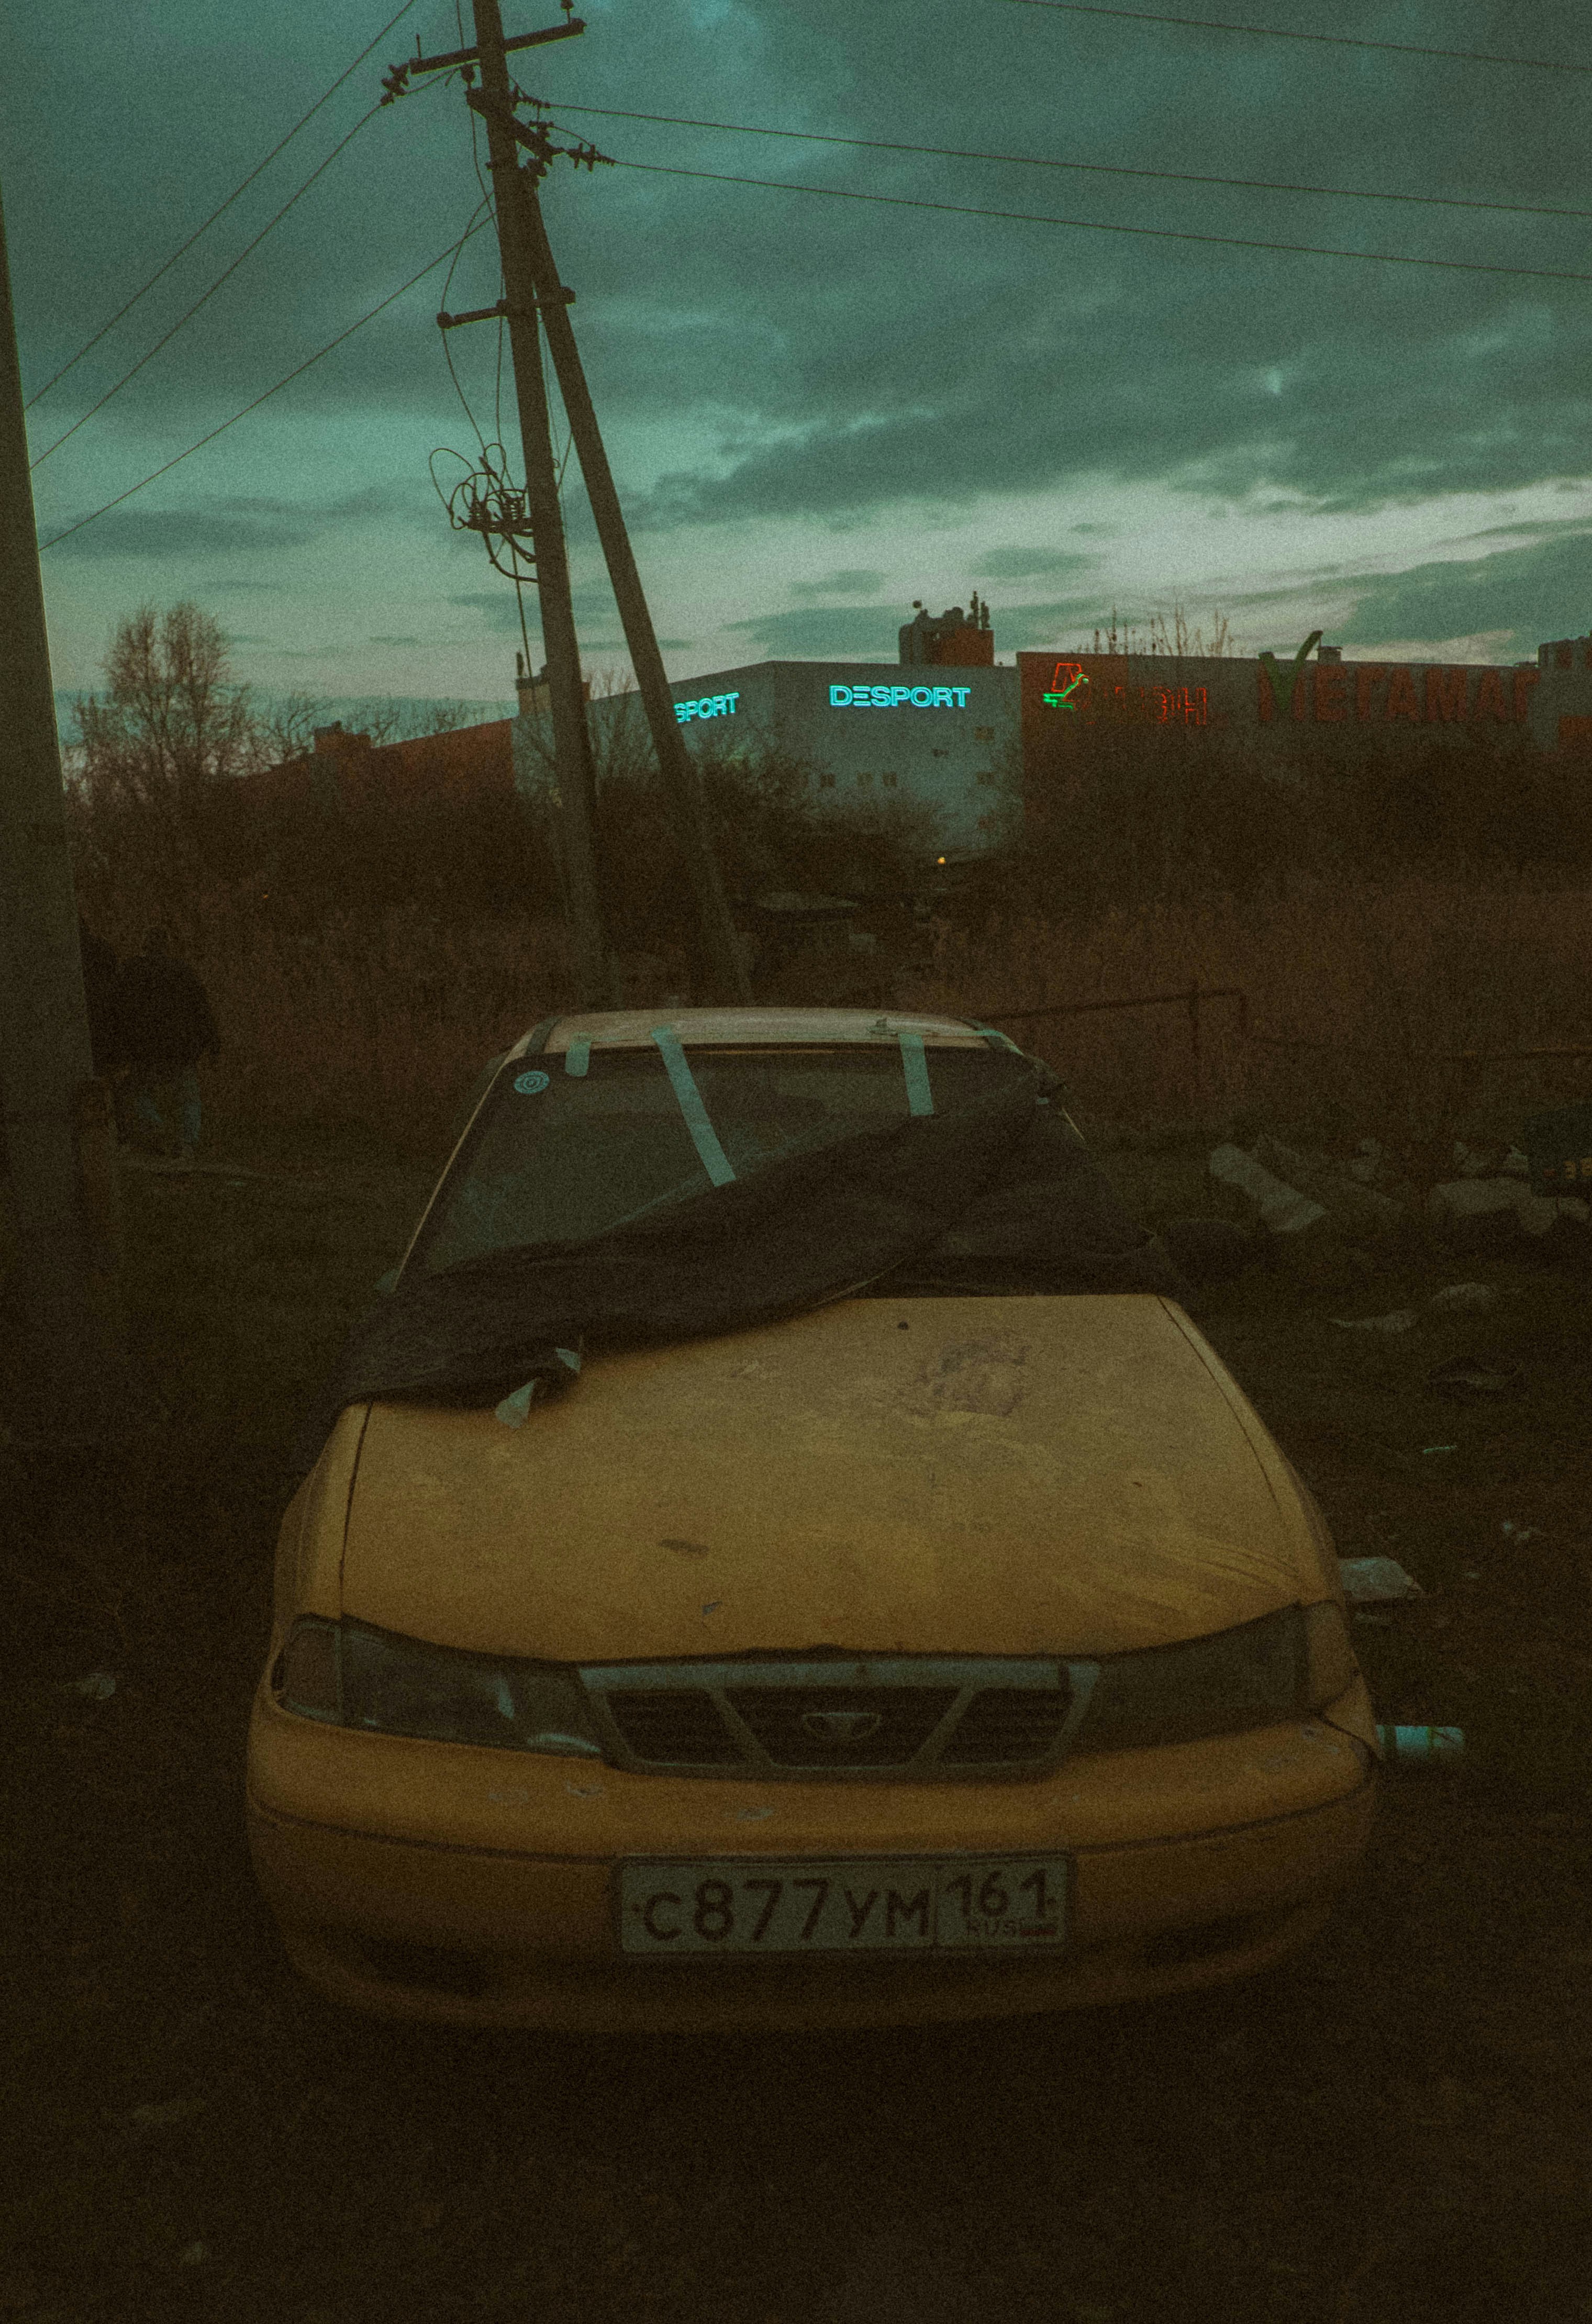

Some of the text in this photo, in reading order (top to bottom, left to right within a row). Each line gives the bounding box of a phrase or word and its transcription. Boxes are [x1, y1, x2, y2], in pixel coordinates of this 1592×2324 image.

[673, 691, 740, 723] SPORT
[829, 685, 971, 707] DESPORT
[643, 1869, 1047, 1941] С877УМ 161
[967, 1919, 1017, 1936] RUS
